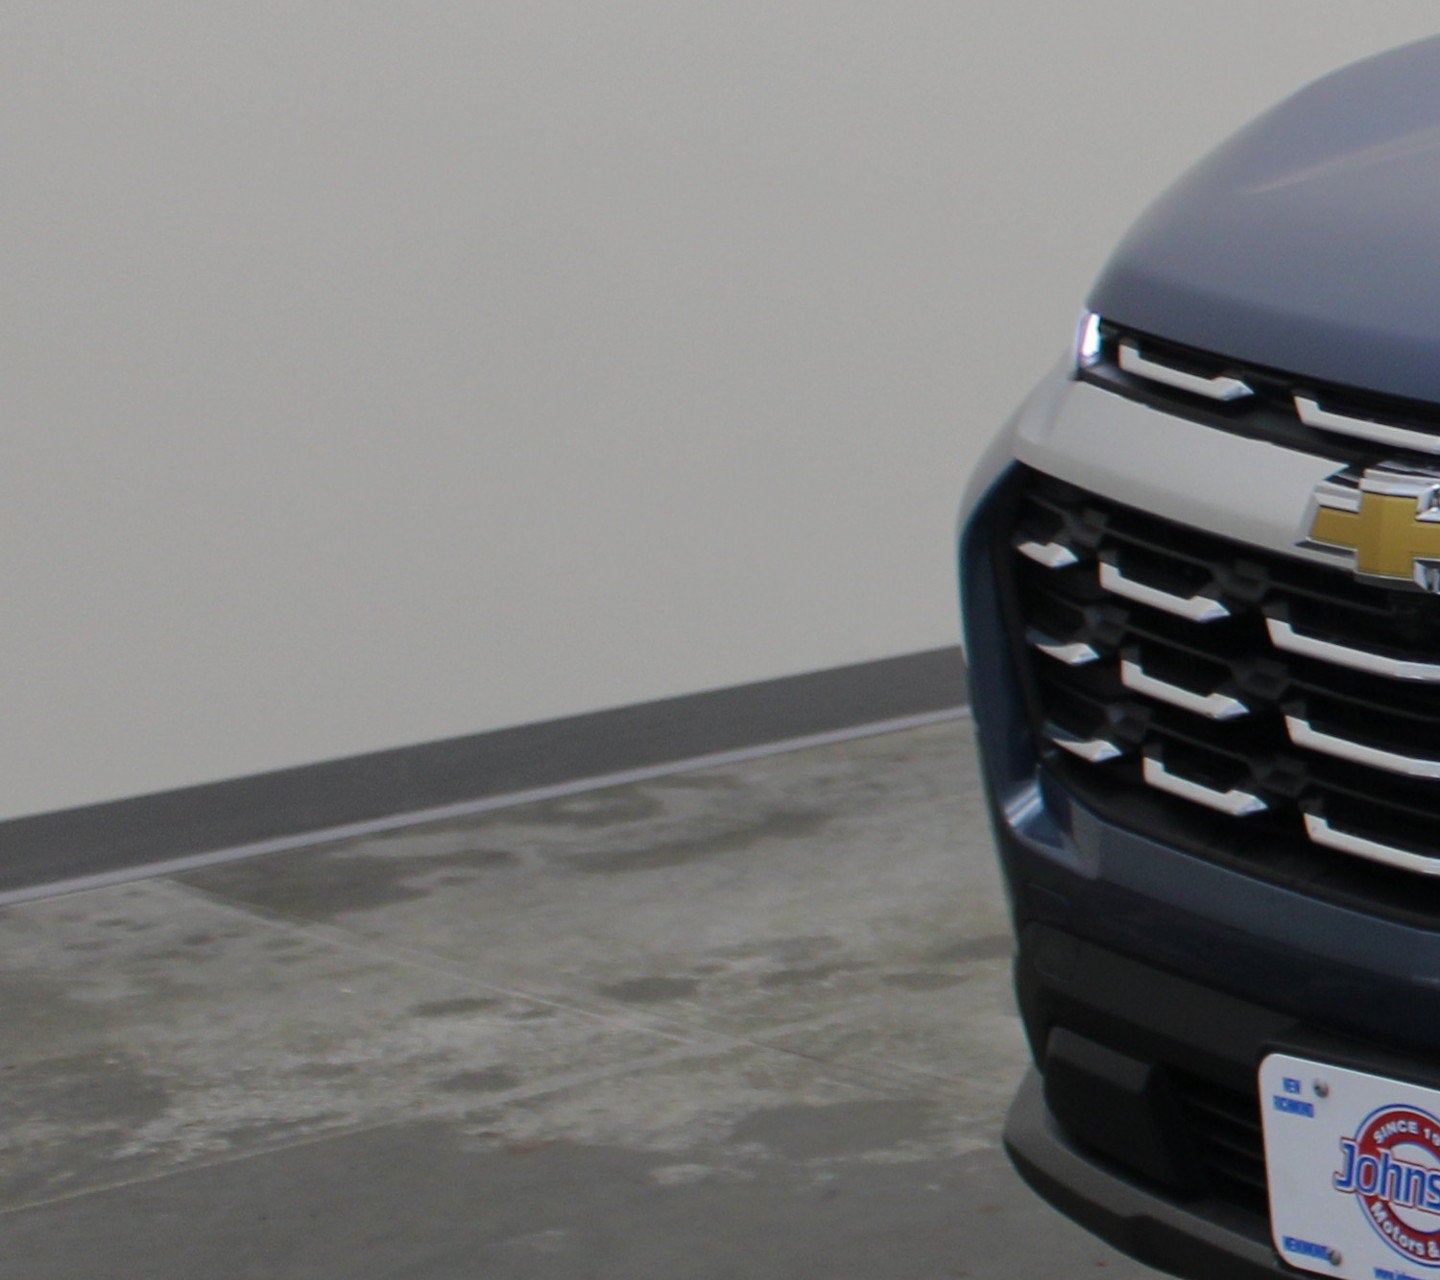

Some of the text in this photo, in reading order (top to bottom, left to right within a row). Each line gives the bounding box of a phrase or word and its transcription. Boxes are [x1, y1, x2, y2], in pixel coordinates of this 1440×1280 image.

[1373, 1119, 1419, 1144] SINCE
[1370, 1200, 1424, 1256] Motors
[1427, 1240, 1440, 1259] &
